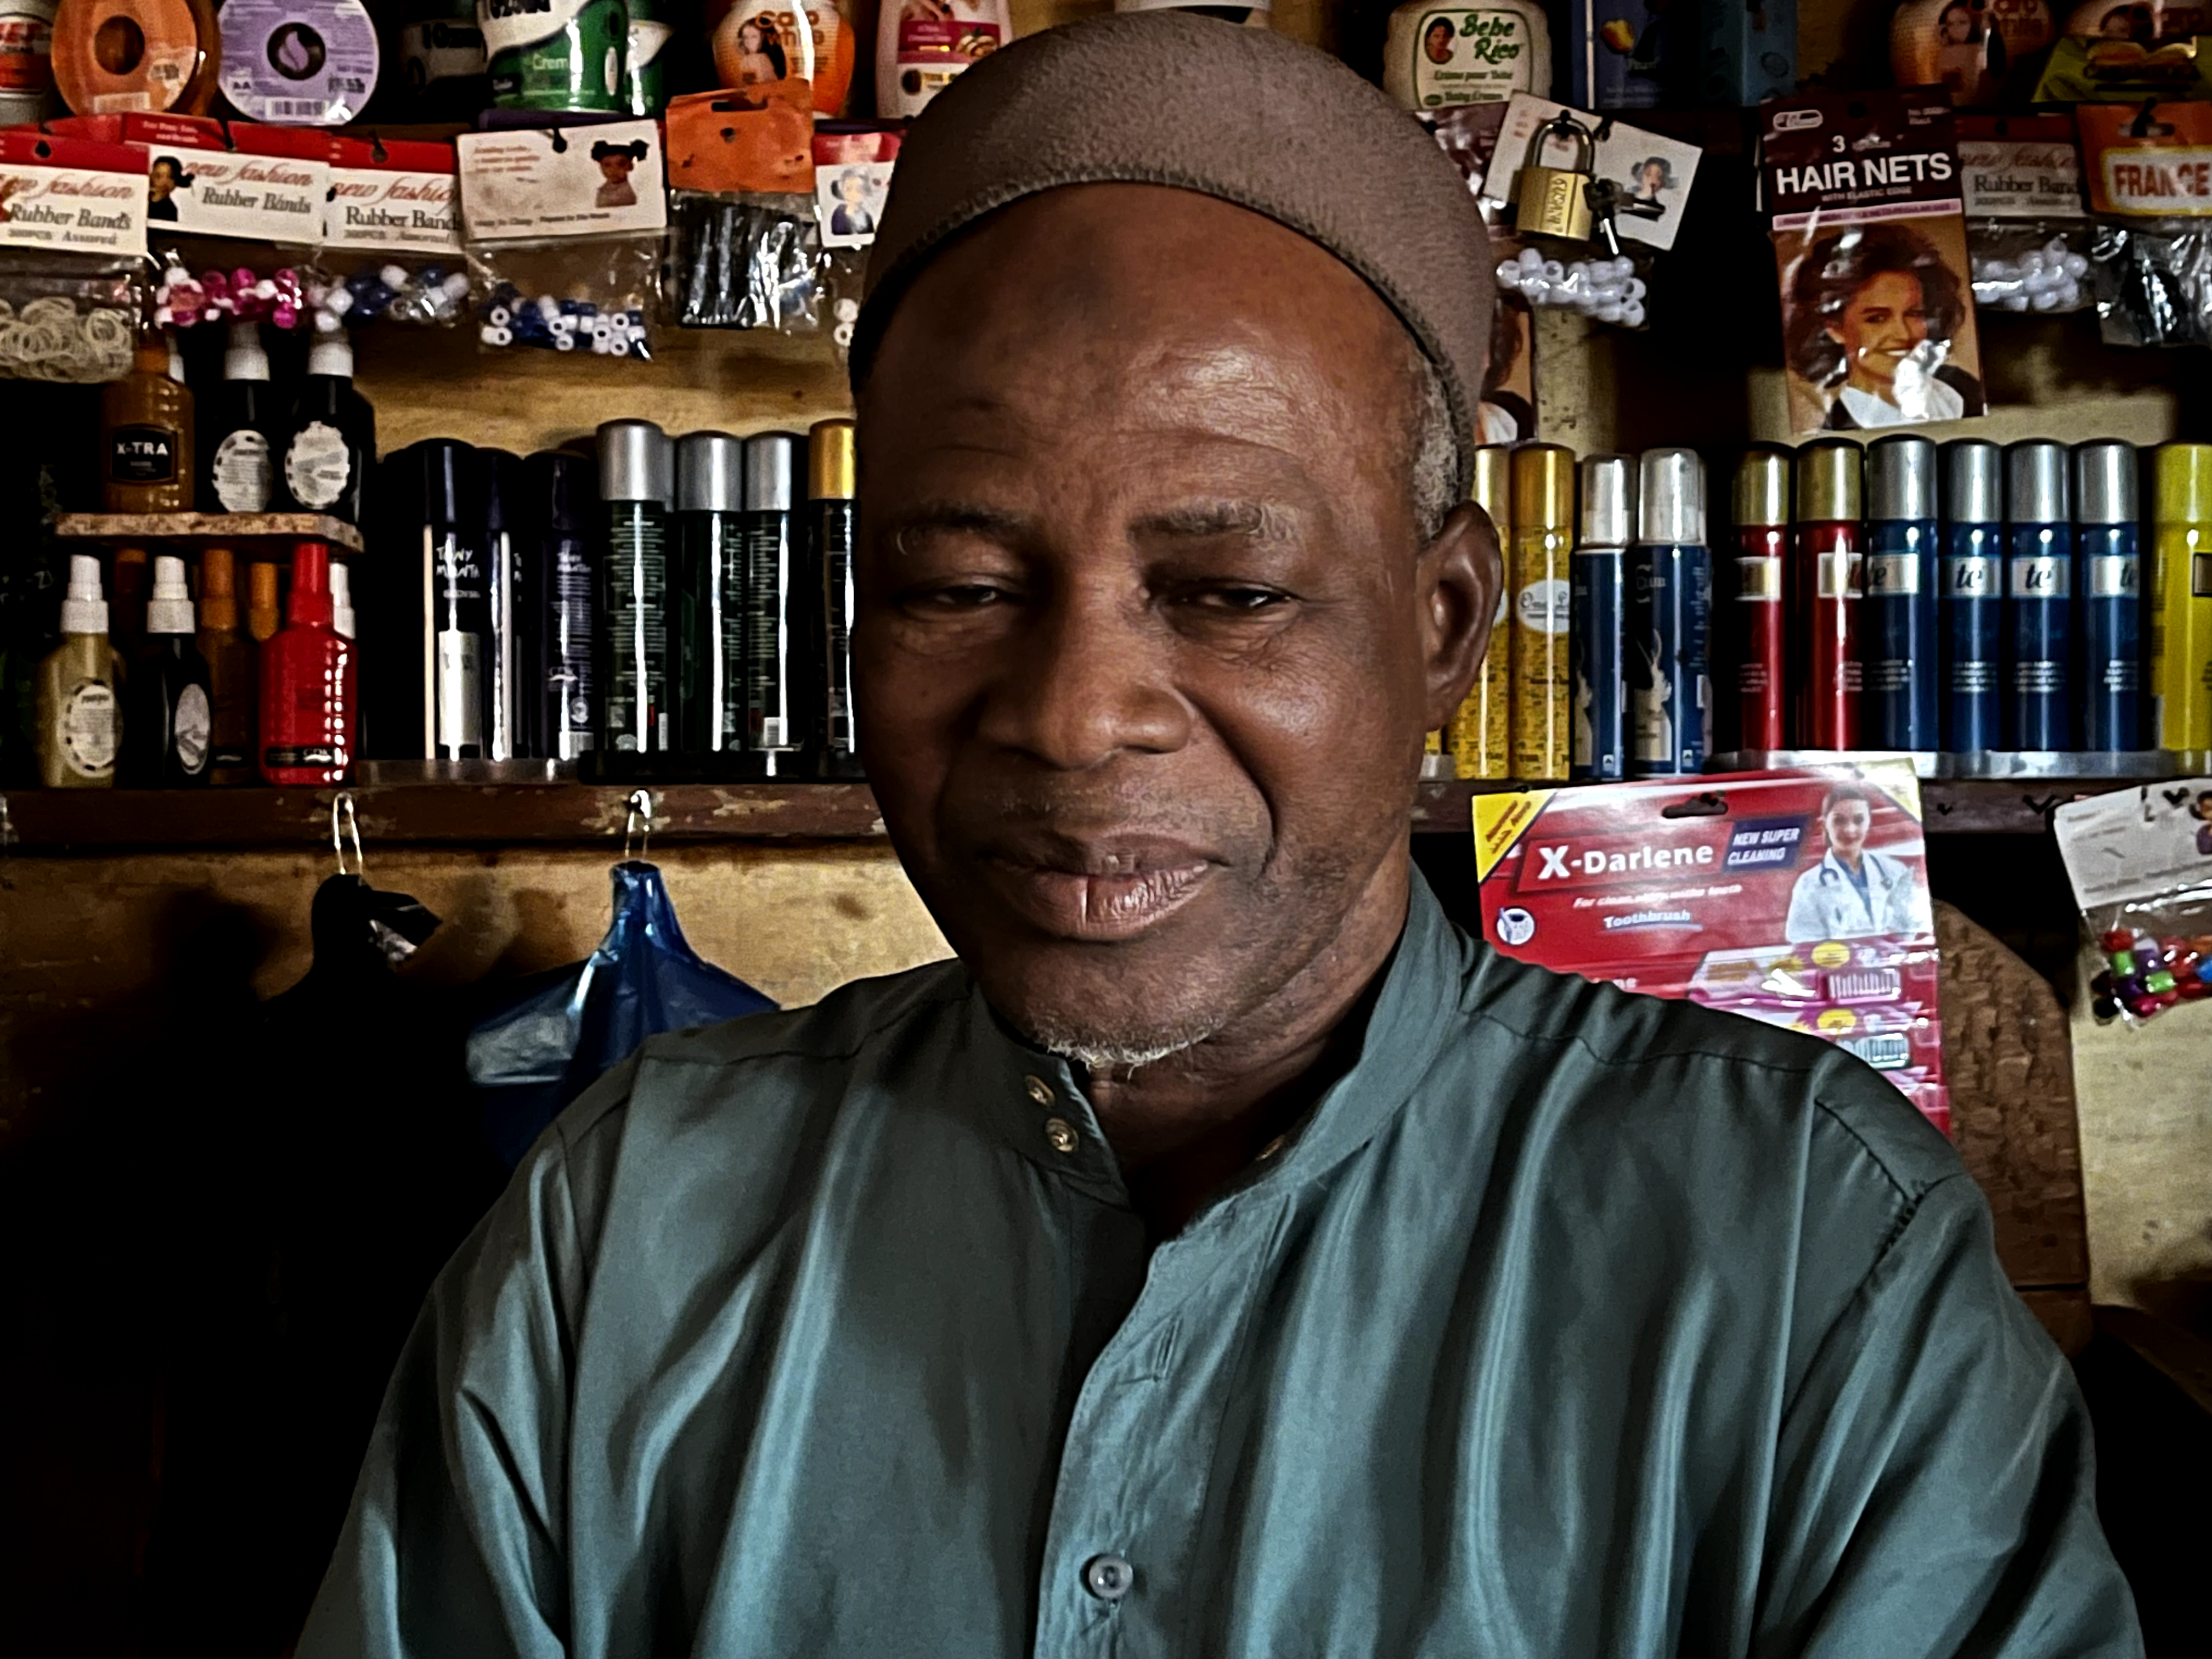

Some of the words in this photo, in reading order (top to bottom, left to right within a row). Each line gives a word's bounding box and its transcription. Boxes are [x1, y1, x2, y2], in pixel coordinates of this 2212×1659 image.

[1460, 14, 1514, 37] Bebe
[1475, 37, 1520, 65] Rico
[1831, 134, 1846, 153] 3
[1776, 161, 1857, 195] HAIR
[1862, 152, 1952, 187] NETS
[1975, 174, 2034, 193] Rubber
[202, 187, 258, 208] Rubber
[263, 192, 311, 213] Bands
[11, 202, 74, 225] Rubber
[77, 208, 132, 229] Bands
[346, 206, 410, 226] Rubber
[116, 441, 169, 456] X-TRA
[1733, 832, 1760, 846] NEW
[1761, 828, 1801, 844] SUPER
[1538, 845, 1713, 880] X-Darlene
[1727, 847, 1786, 865] CLEANING
[1604, 909, 1691, 929] Toothbrush
